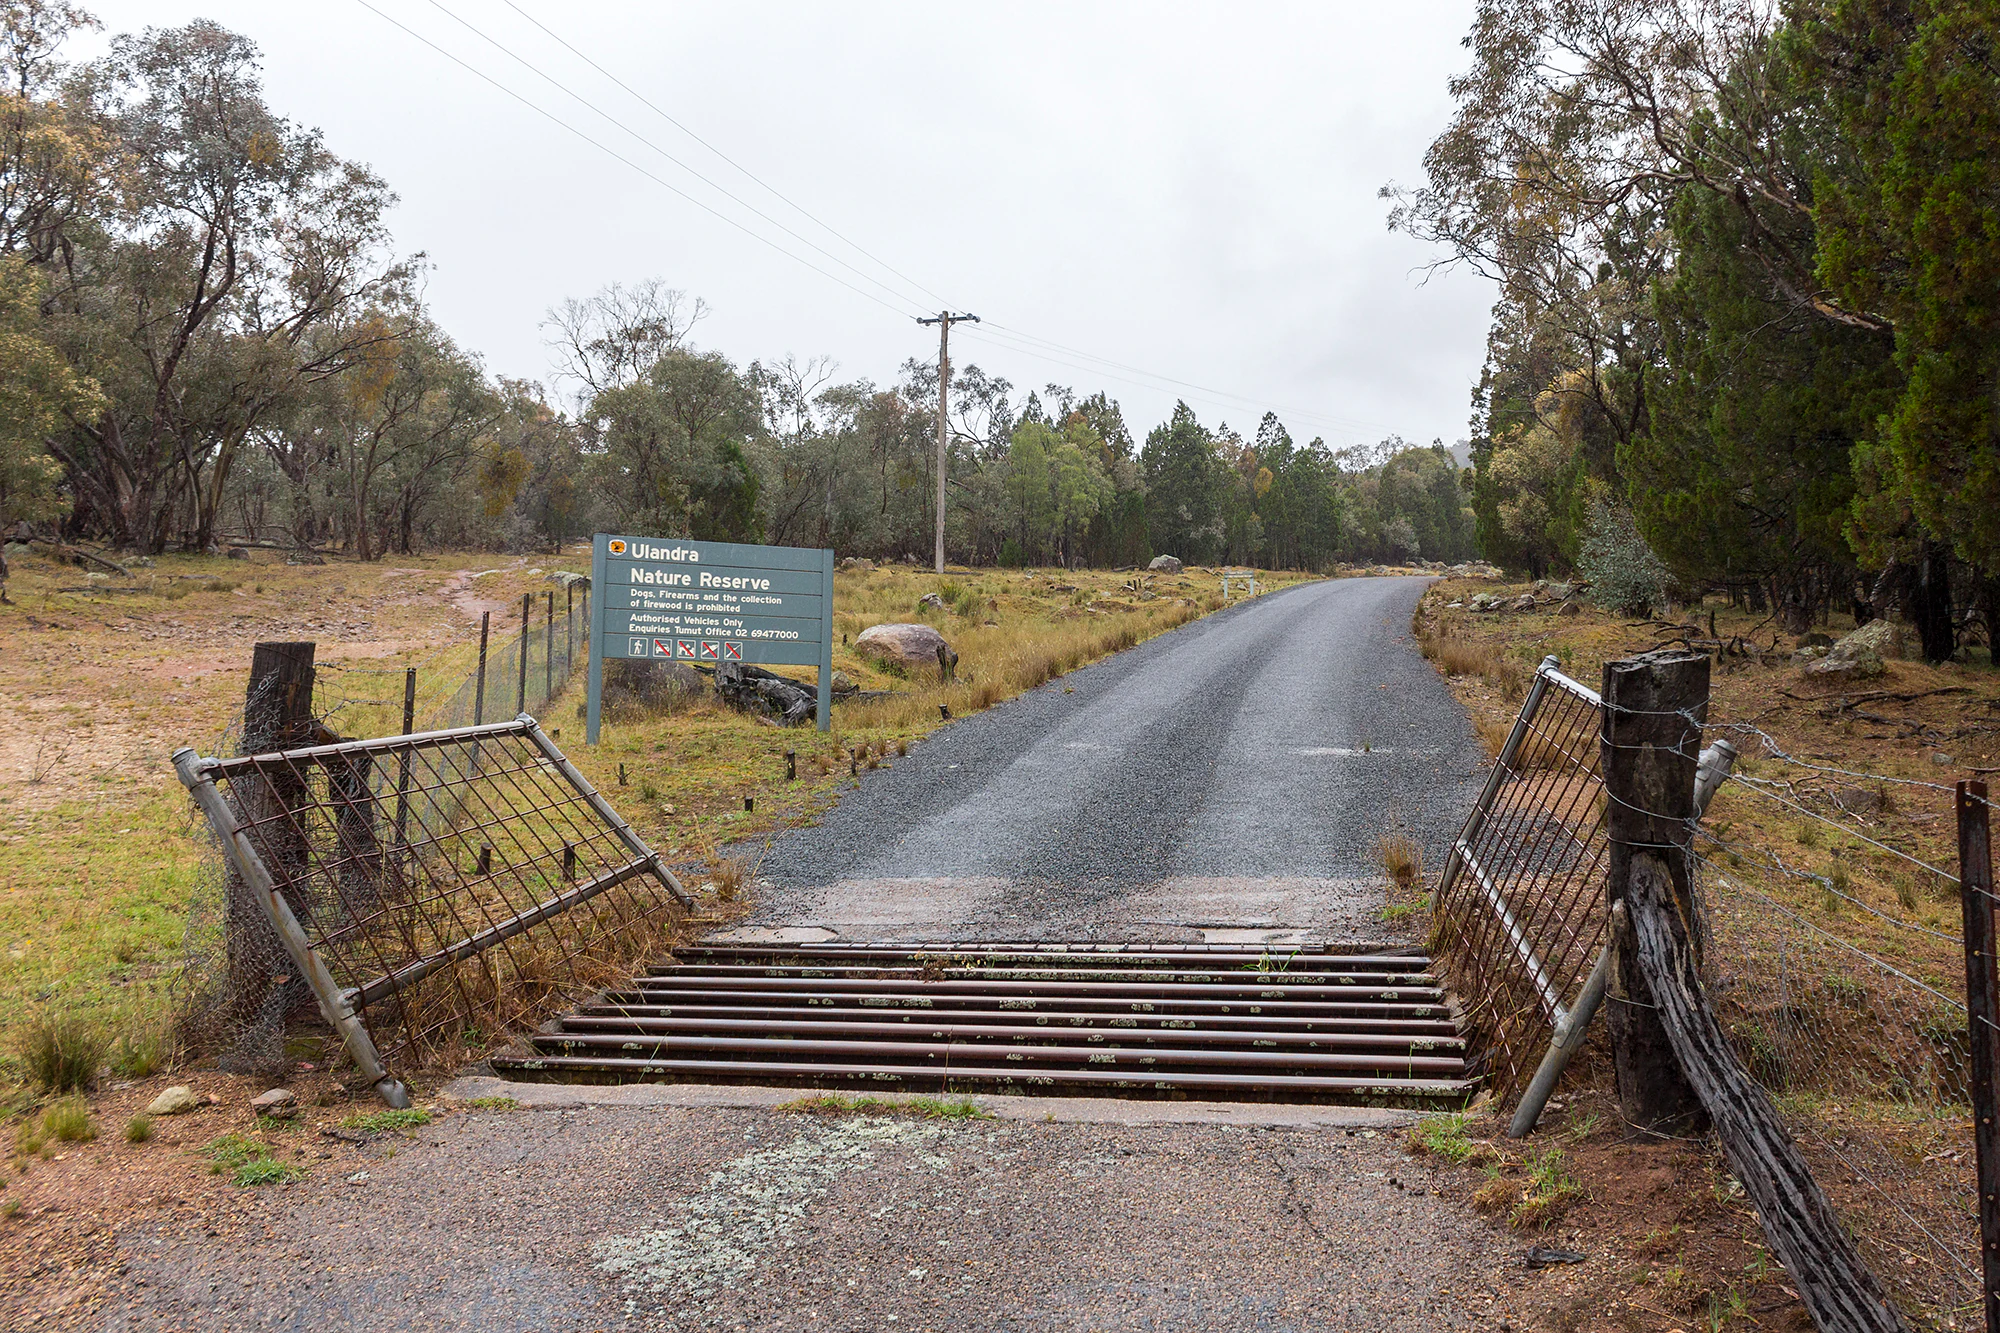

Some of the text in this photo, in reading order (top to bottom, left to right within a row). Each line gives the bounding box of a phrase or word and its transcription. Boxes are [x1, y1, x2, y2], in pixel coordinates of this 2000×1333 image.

[631, 543, 699, 562] Ulandra
[631, 568, 770, 590] Nature Reserve
[659, 590, 700, 601] Firearms
[703, 594, 719, 602] and
[723, 594, 738, 602] the
[741, 595, 782, 604] collection
[630, 599, 741, 612] of firewood is prohibited
[630, 613, 743, 628] Authorised Vehicles Only
[629, 623, 799, 639] Enquiries Tumut Office 02 69477000
